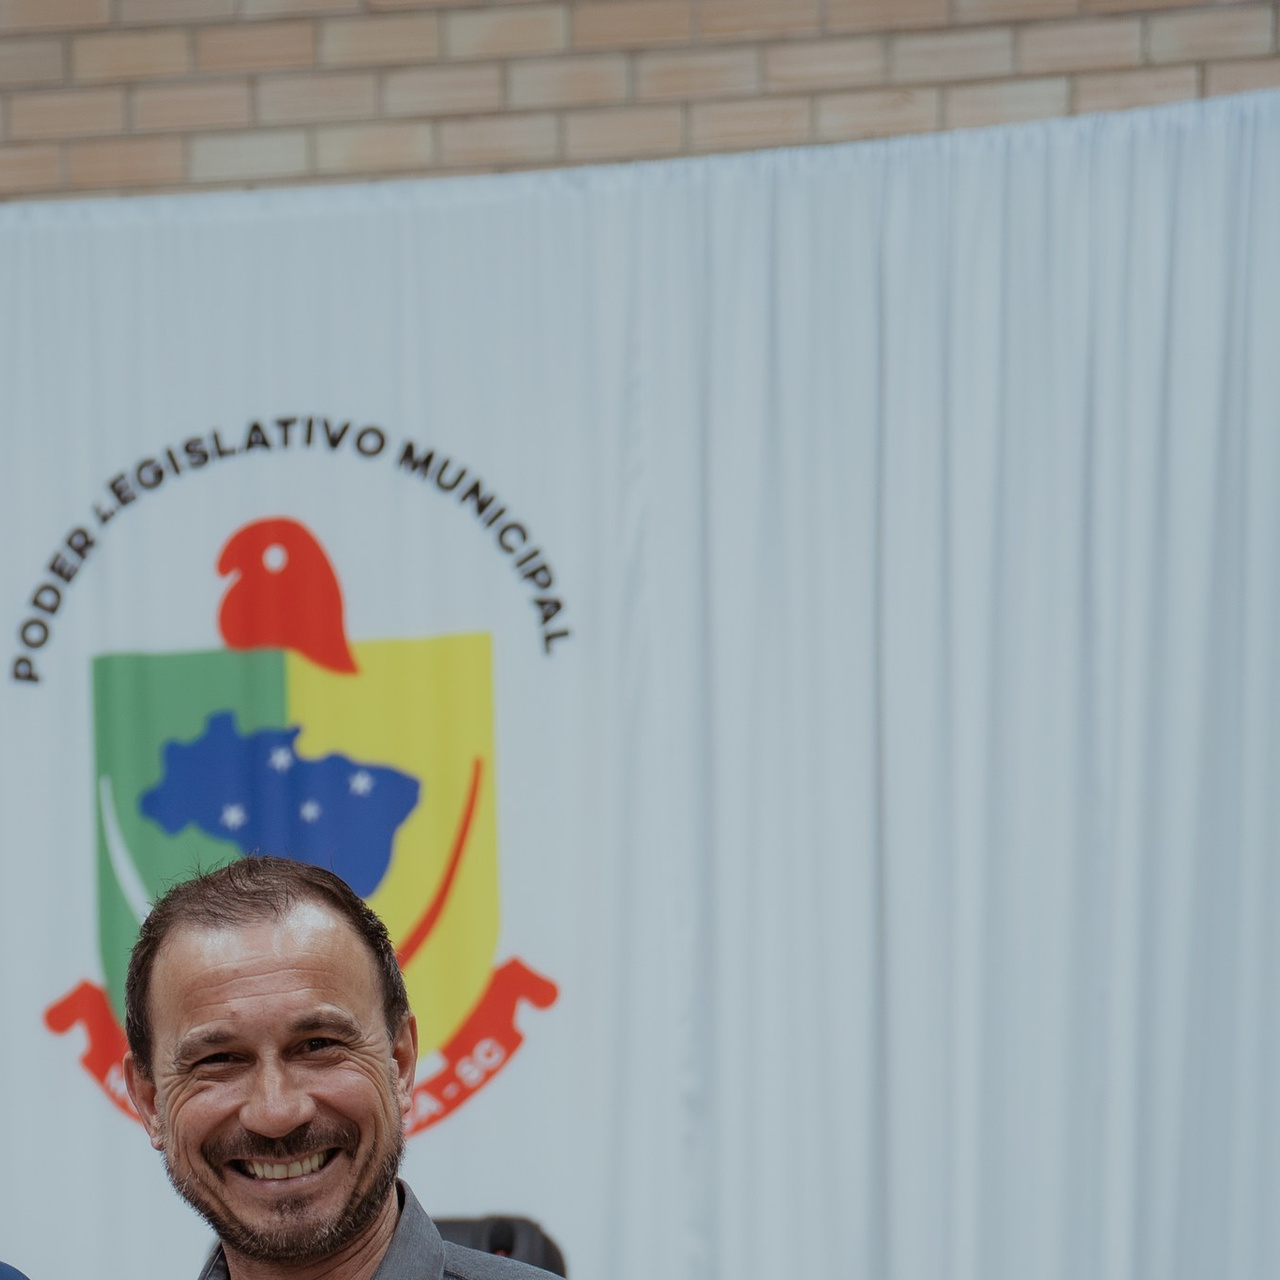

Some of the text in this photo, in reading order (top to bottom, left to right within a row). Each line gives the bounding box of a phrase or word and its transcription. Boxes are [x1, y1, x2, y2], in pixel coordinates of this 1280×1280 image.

[11, 416, 573, 685] PODER LEGISLATIVO MUNICIPAL
